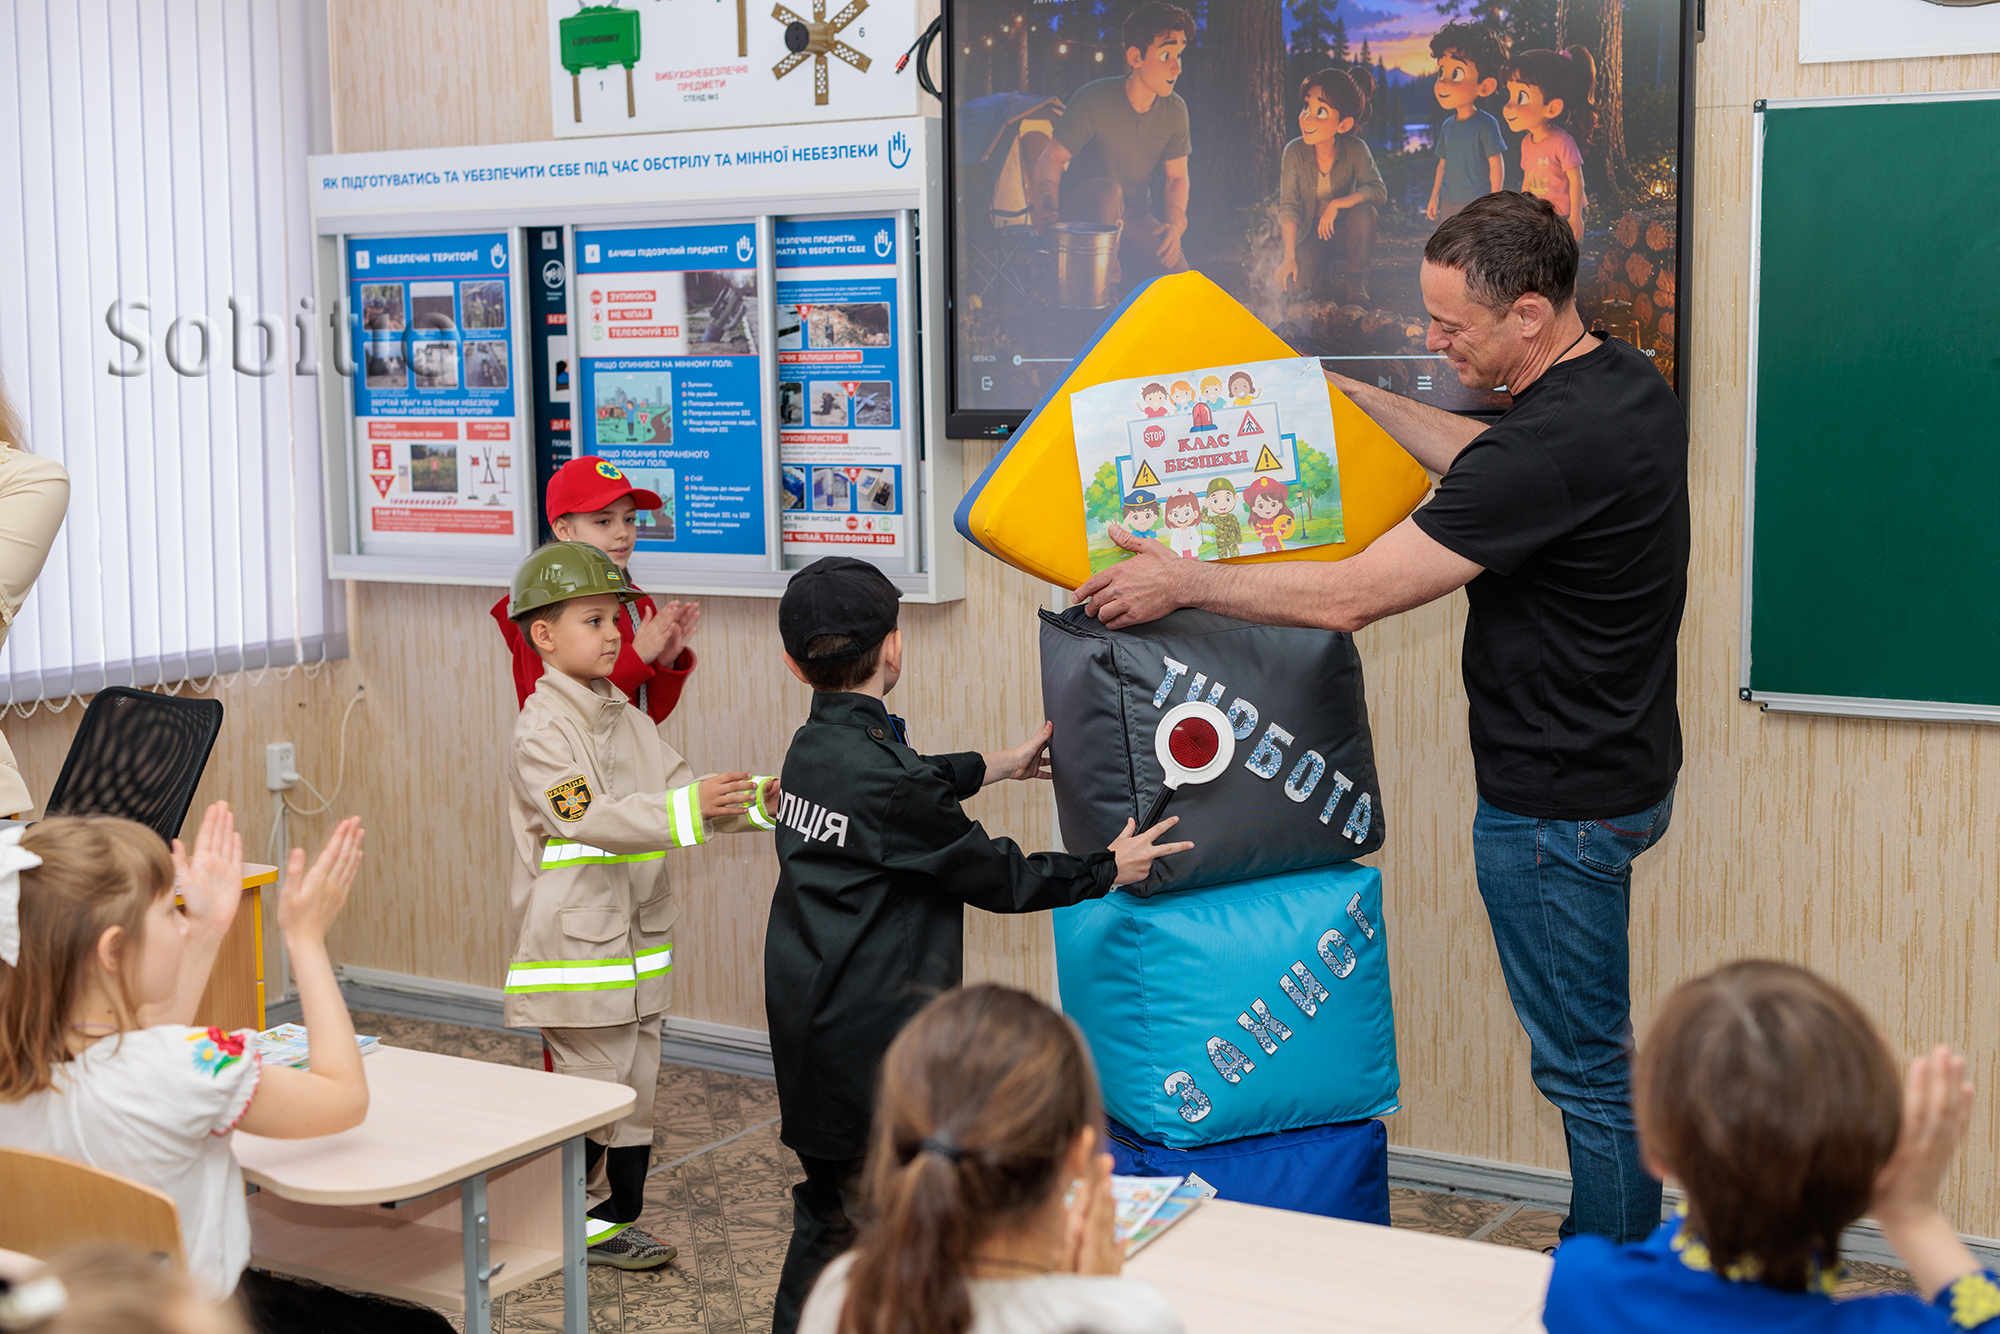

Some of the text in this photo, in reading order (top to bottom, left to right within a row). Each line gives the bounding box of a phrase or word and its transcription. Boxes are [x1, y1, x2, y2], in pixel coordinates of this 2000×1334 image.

[859, 27, 865, 38] 6
[655, 65, 748, 81] ВИБУХОНЕБЕЗПЕЧНІ
[599, 80, 604, 90] 1
[677, 79, 726, 91] ПРЕДМЕТИ
[322, 143, 878, 191] ЯК ПІДГОТУВАТИСЬ ТА УБЕЗПЕЧИТИ СЕБЕ ПІД ЧАС ОБСТРІЛУ ТА МІННОЇ НЕБЕЗПЕКИ
[776, 234, 856, 245] БЕЗПЕЧНІ ПРЕДМЕТИ:
[608, 245, 728, 258] БАЧИШ ПІДОЗРІЛИЙ ПРЕДМЕТ?
[847, 245, 866, 253] СЕБЕ
[376, 249, 478, 264] НЕБЕЗПЕЧНІ ТЕРИТОРІЇ
[609, 291, 655, 301] ЗУПИНИСЬ
[610, 308, 650, 320] НЕ ЧІПАЙ
[611, 326, 678, 337] ТЕЛЕФОНУЙ 101
[798, 353, 834, 361] ЗАЛИШКИ
[594, 362, 617, 370] ЯКЩО
[675, 360, 710, 368] МІННОМУ
[1144, 430, 1164, 443] STOP
[1178, 434, 1230, 452] КЛАС
[622, 450, 657, 458] ПОБАЧИВ
[658, 450, 709, 459] ПОРАНЕНОГО
[1164, 450, 1249, 473] БЕЗПЕКИ
[825, 534, 874, 542] ТЕЛЕФОНУЙ
[876, 535, 893, 543] 101!
[1163, 891, 1375, 1123] ЗАХИСТ
